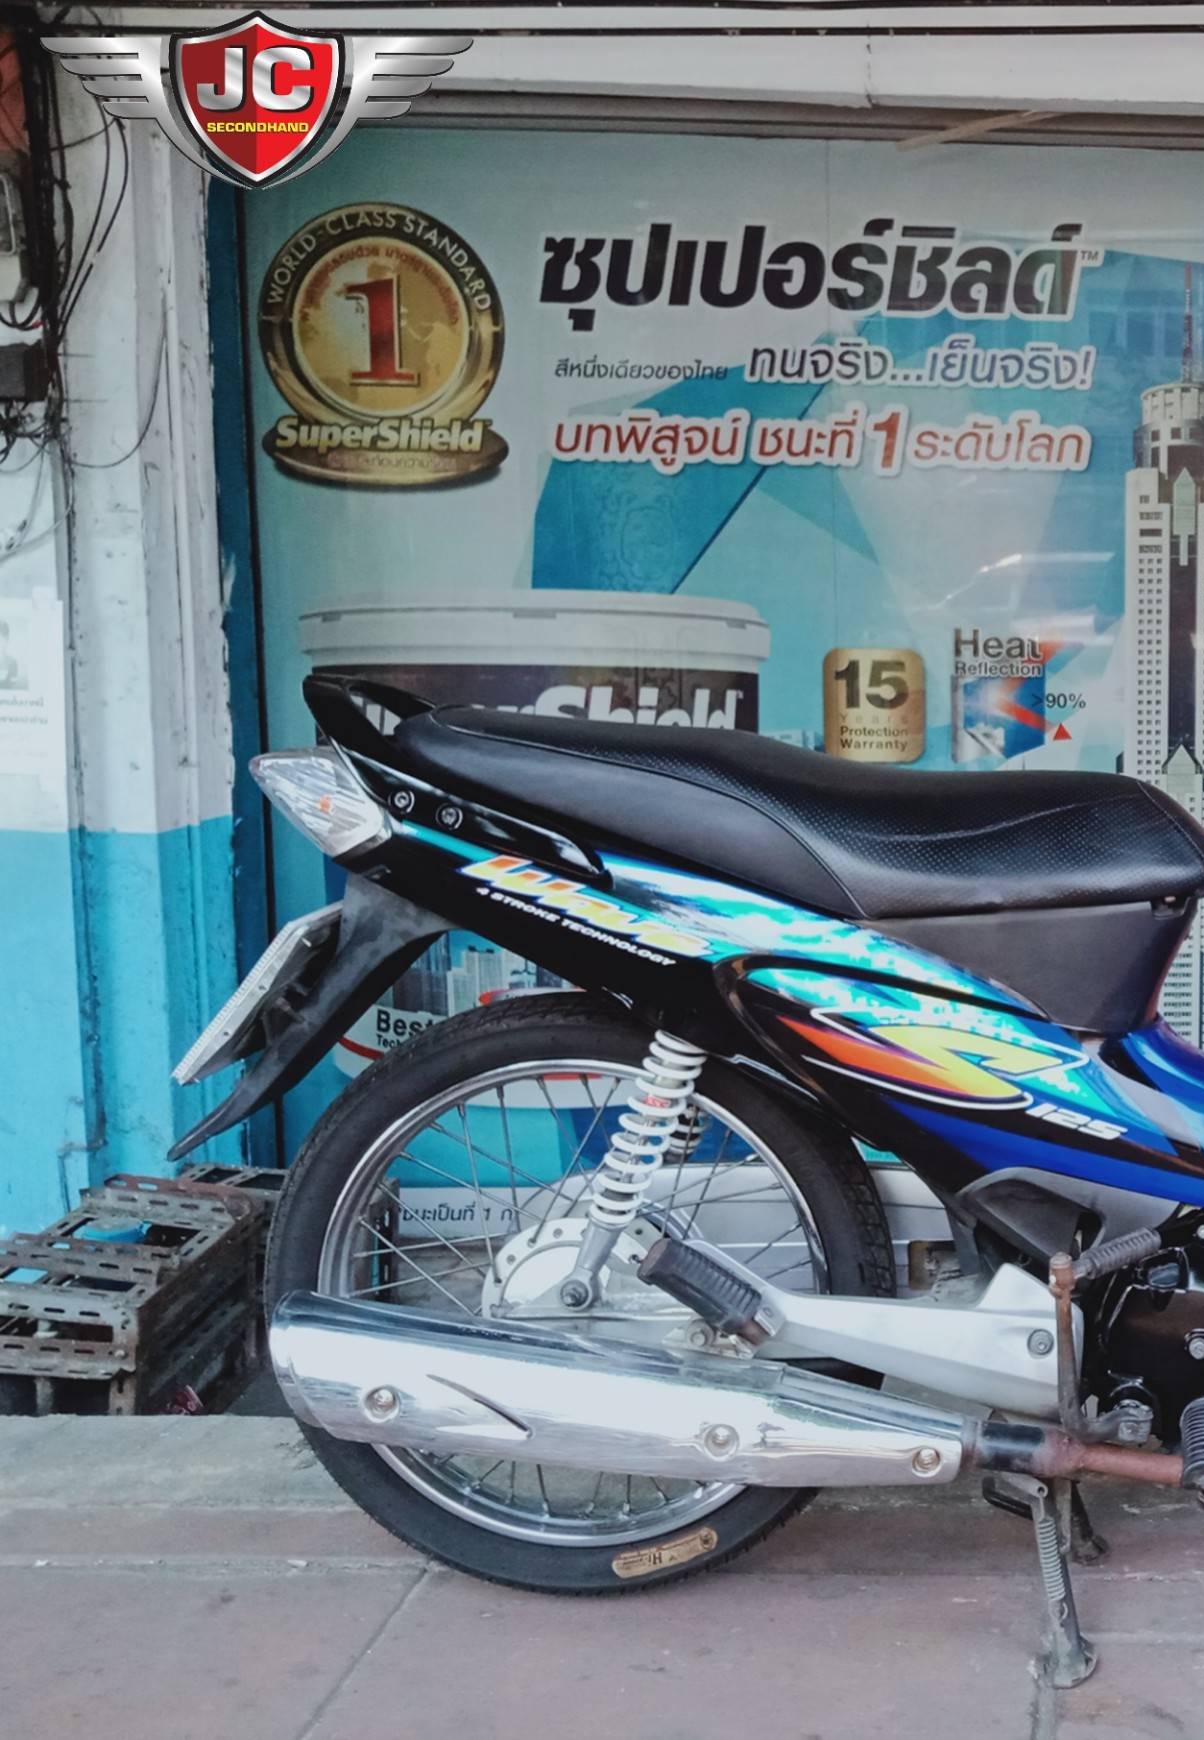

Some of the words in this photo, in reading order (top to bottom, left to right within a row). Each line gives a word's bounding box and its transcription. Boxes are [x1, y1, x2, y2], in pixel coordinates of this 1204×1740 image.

[402, 214, 494, 312] STANDARD
[342, 277, 419, 387] 1
[554, 354, 728, 381] สีหนึ่งเดียวของไทย
[275, 417, 485, 453] SuperShield
[554, 416, 742, 467] บทพิสูจน์
[757, 409, 860, 460] ชนะที่
[872, 412, 902, 468] 1
[913, 417, 1085, 466] ระดับโลก
[834, 659, 910, 710] 15
[954, 661, 1042, 676] Reflection
[840, 726, 908, 737] Protection
[840, 738, 908, 751] Warranty
[490, 892, 561, 923] STROKE
[561, 918, 677, 966] TECHNOLOGY
[1025, 1103, 1128, 1140] 125
